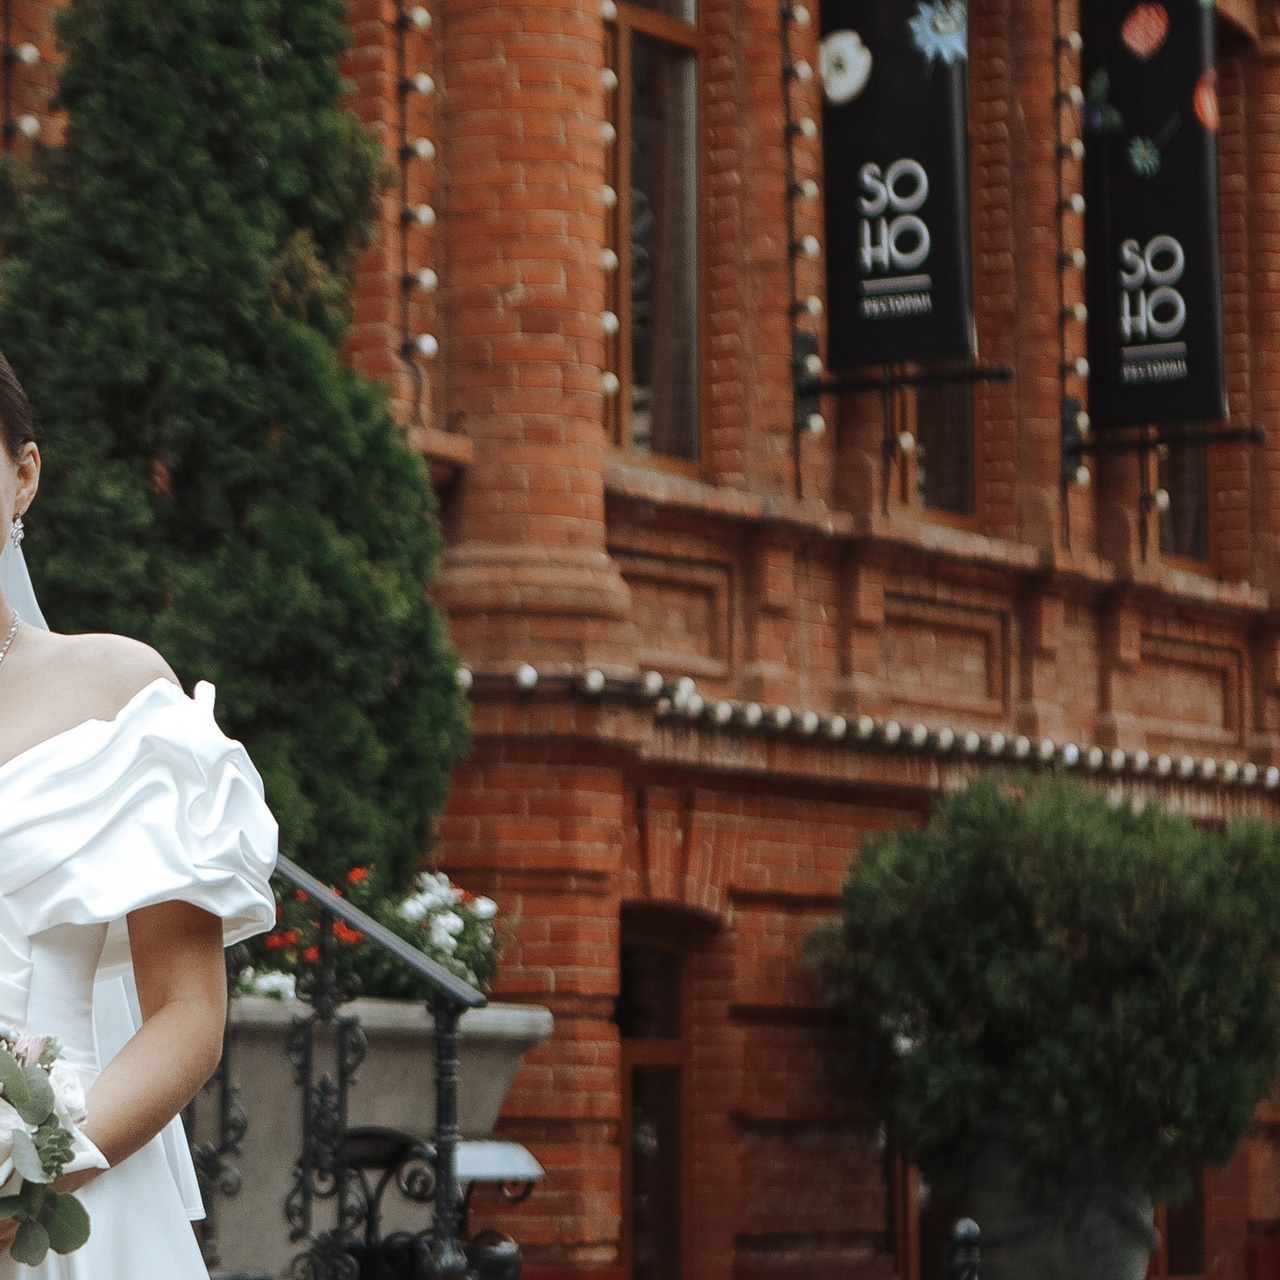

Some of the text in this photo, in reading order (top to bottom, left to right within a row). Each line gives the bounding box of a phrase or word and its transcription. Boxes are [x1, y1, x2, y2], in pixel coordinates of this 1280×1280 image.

[859, 158, 930, 217] SO
[860, 214, 931, 271] HO
[1120, 235, 1185, 289] SO
[1121, 285, 1186, 342] HO
